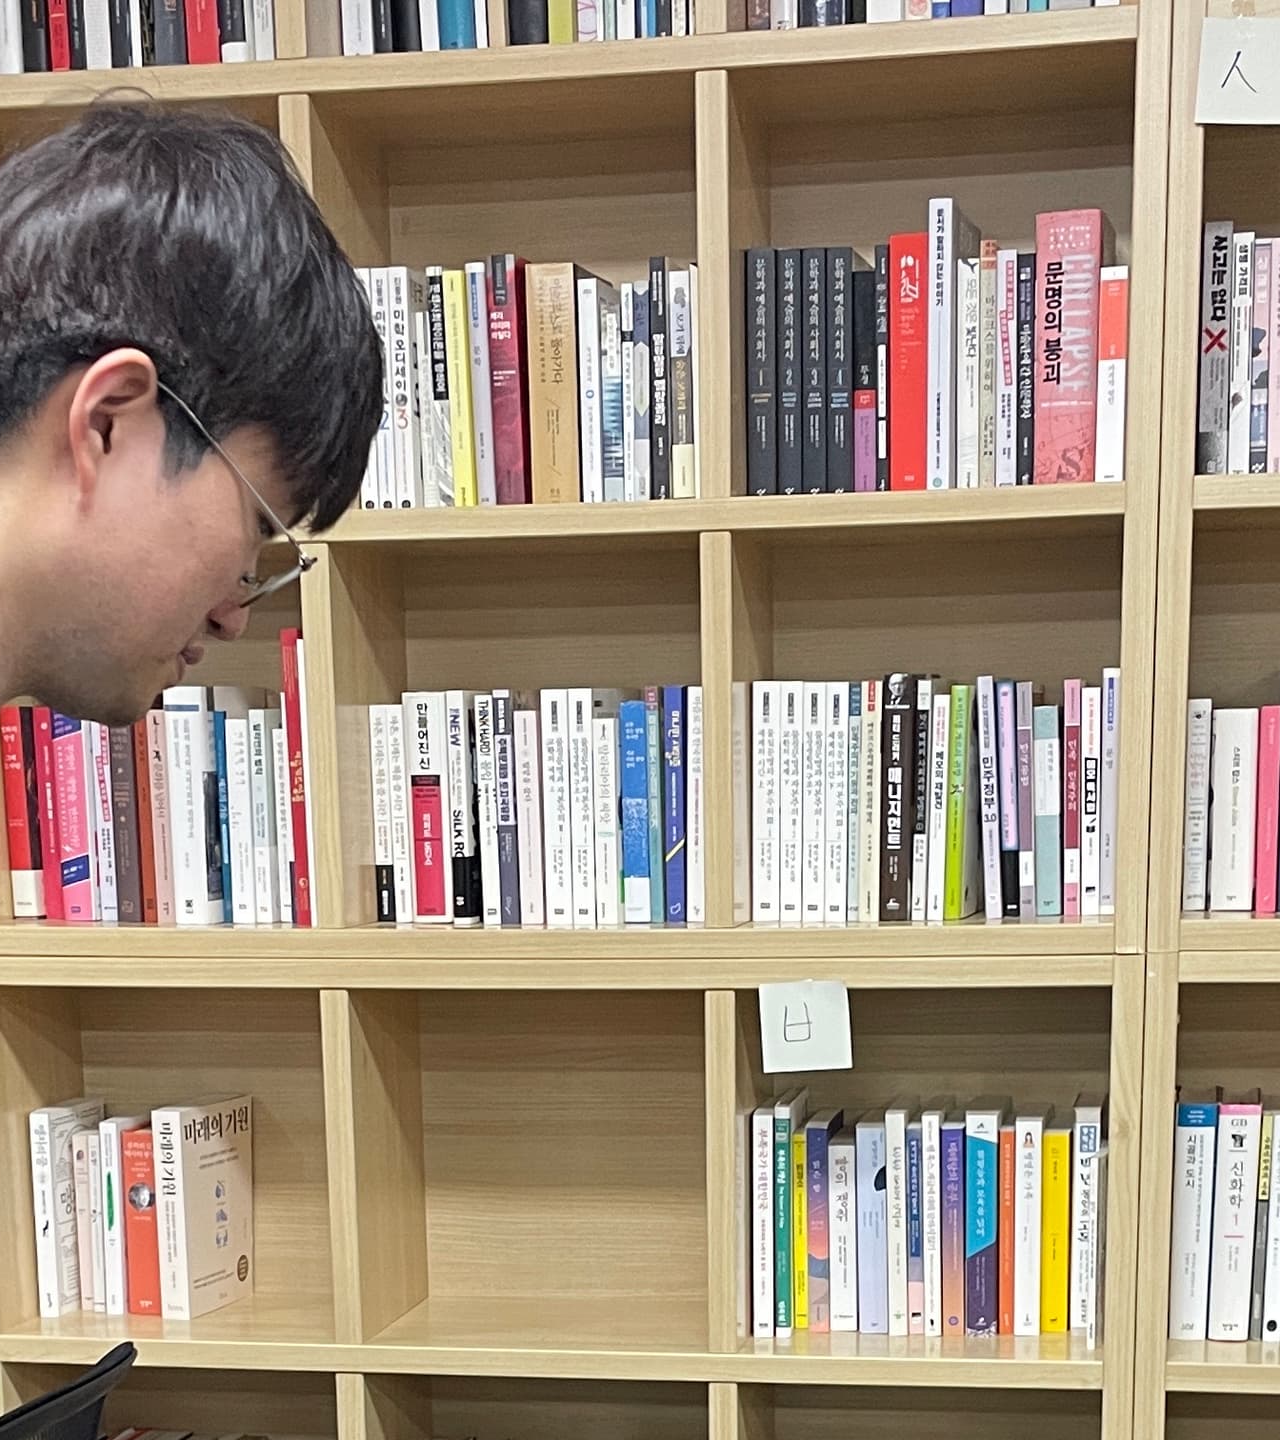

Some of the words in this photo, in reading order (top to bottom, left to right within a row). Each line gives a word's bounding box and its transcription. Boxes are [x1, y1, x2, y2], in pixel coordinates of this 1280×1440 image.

[1221, 50, 1257, 93] ㅅ
[754, 258, 766, 292] 문학과
[1211, 234, 1229, 284] 사고는
[754, 293, 766, 326] 예술의
[1044, 262, 1064, 334] 문명의
[1210, 289, 1227, 322] 없다
[394, 310, 406, 335] 미학
[1059, 255, 1097, 392] COLLAPSE
[754, 329, 766, 361] 사회사
[1020, 324, 1032, 364] 미술관에
[1042, 339, 1062, 385] 붕괴
[394, 340, 407, 392] 오디세이
[1020, 367, 1030, 377] 간
[397, 408, 409, 429] 3
[1020, 379, 1031, 419] 인문학자
[381, 409, 390, 430] 2
[417, 703, 429, 754] 만들어진
[449, 713, 462, 747] NEW
[478, 700, 491, 727] THINK
[479, 728, 489, 756] HARD!
[497, 737, 508, 778] 주택문제와
[419, 758, 430, 770] 신
[599, 744, 611, 800] 말라리아의
[983, 756, 995, 809] 민주정부
[498, 780, 510, 823] 토지국유화
[599, 802, 612, 824] 씨앗
[887, 766, 903, 850] 매니지먼트
[783, 1001, 812, 1042] ㅂ
[183, 1113, 223, 1143] 미래의
[225, 1106, 249, 1135] 기원
[160, 1122, 173, 1168] 미래의
[162, 1169, 176, 1196] 기원
[757, 1172, 769, 1211] 대한민국
[1185, 1166, 1195, 1189] 도시
[1230, 1161, 1245, 1209] 신화학
